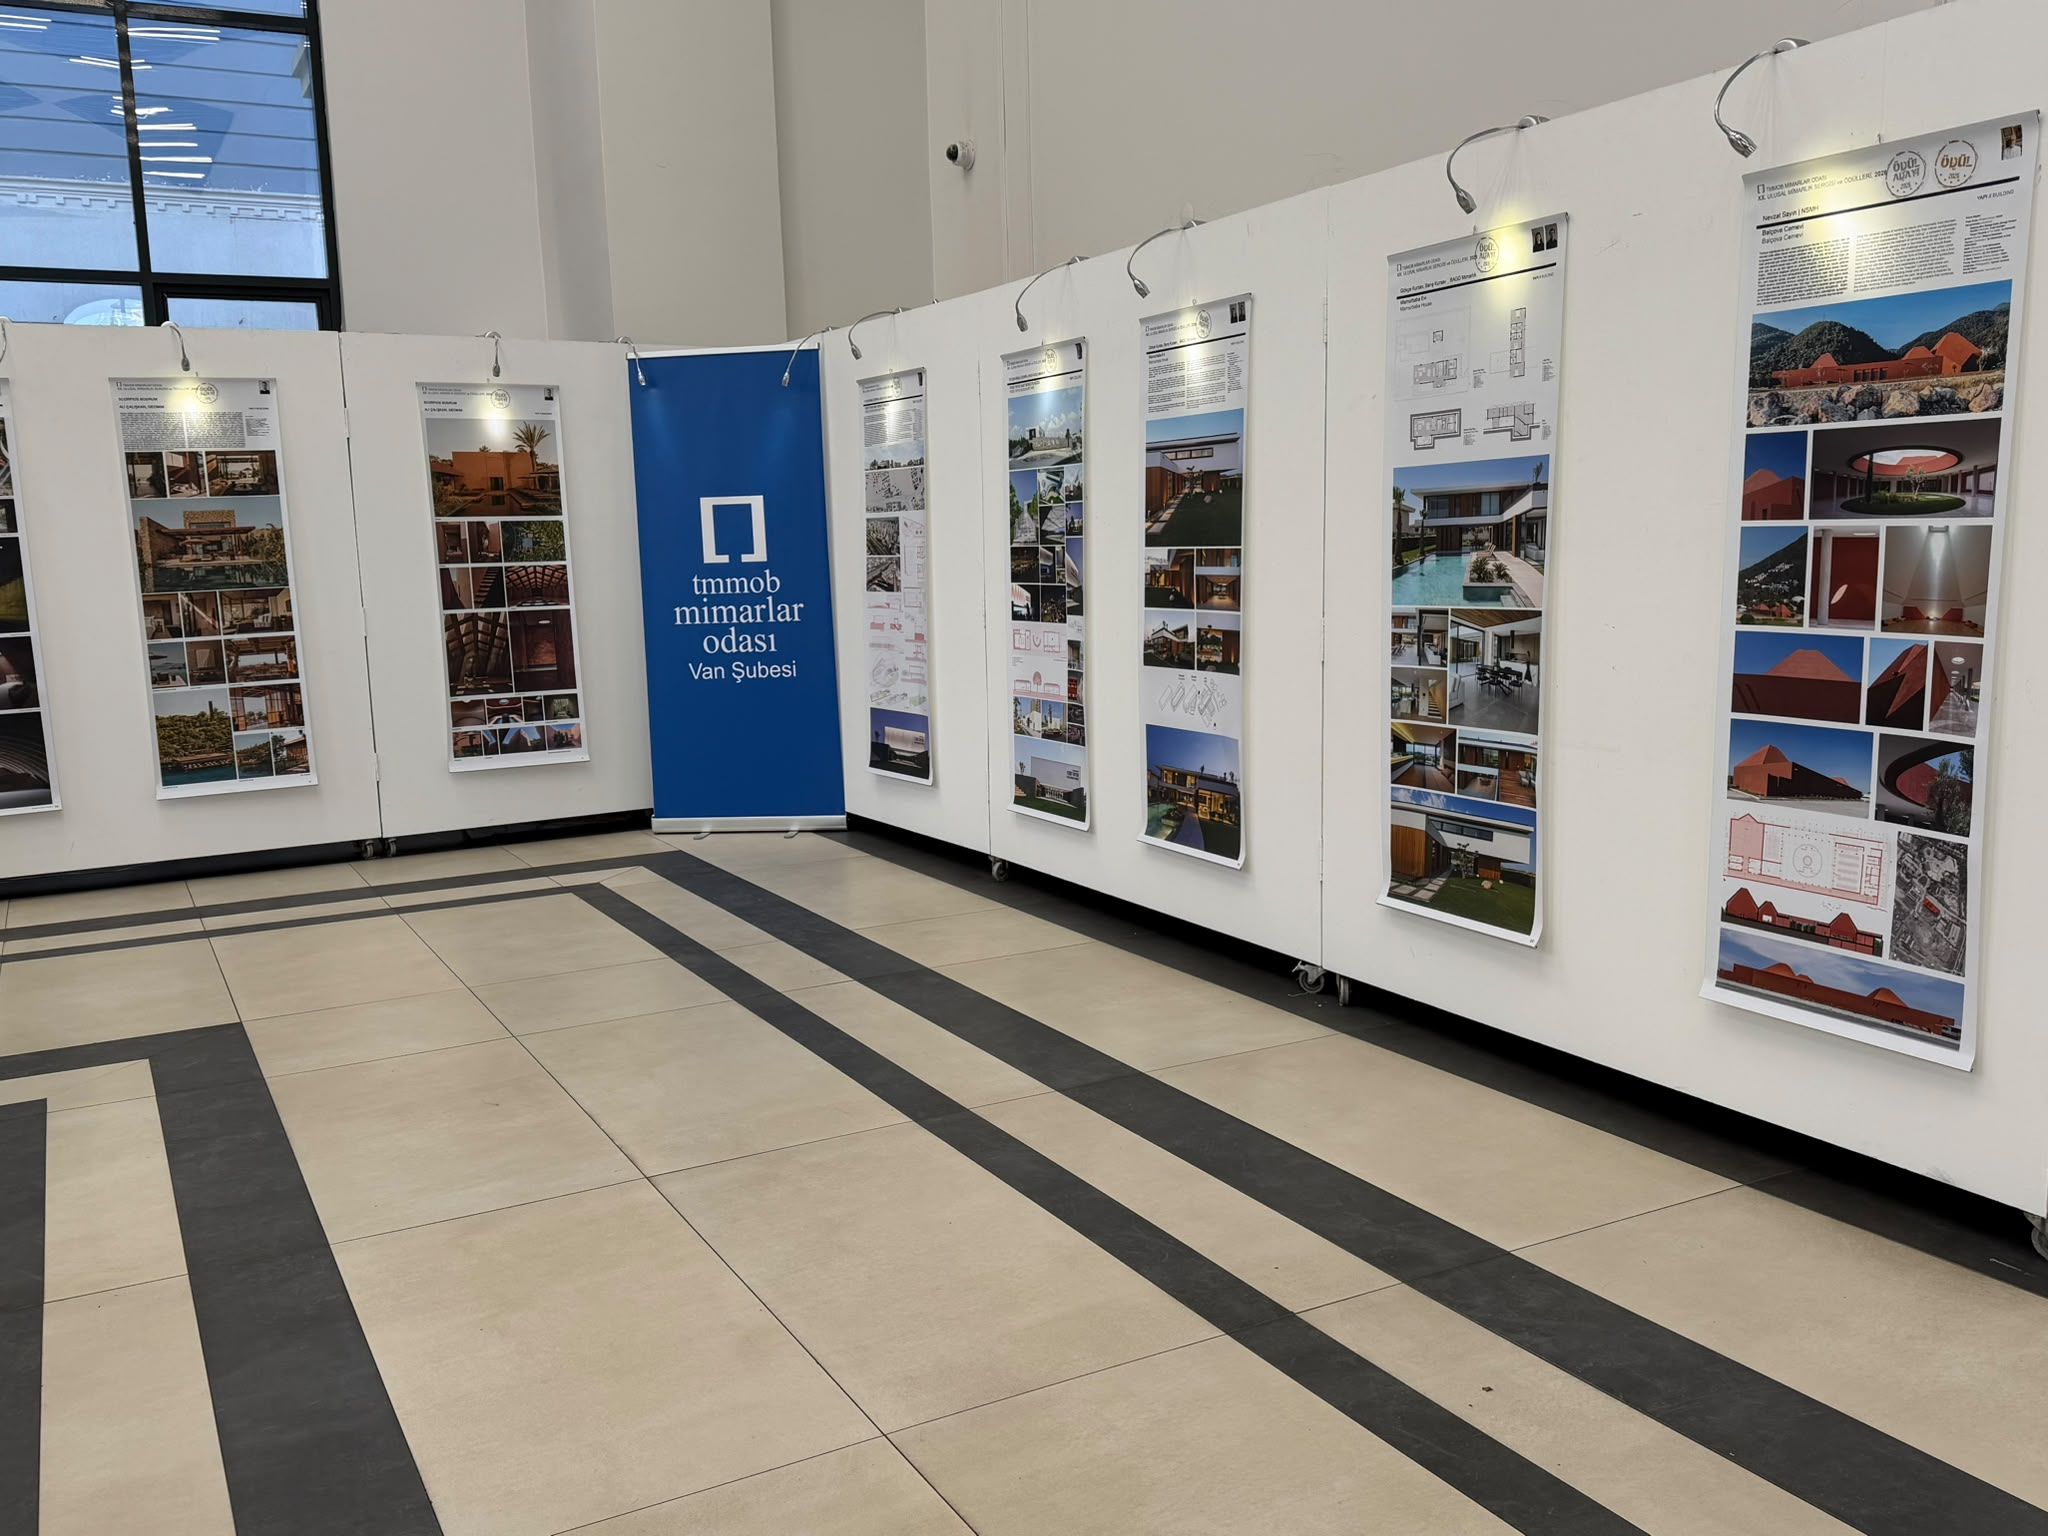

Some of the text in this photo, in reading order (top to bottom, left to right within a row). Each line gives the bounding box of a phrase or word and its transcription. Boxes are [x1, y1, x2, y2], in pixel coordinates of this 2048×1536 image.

[1941, 154, 1973, 170] ÖDÜL
[692, 569, 781, 595] tmmob
[674, 595, 805, 625] mimarlar
[703, 626, 777, 654] odası
[688, 660, 797, 684] Van Şubesi
